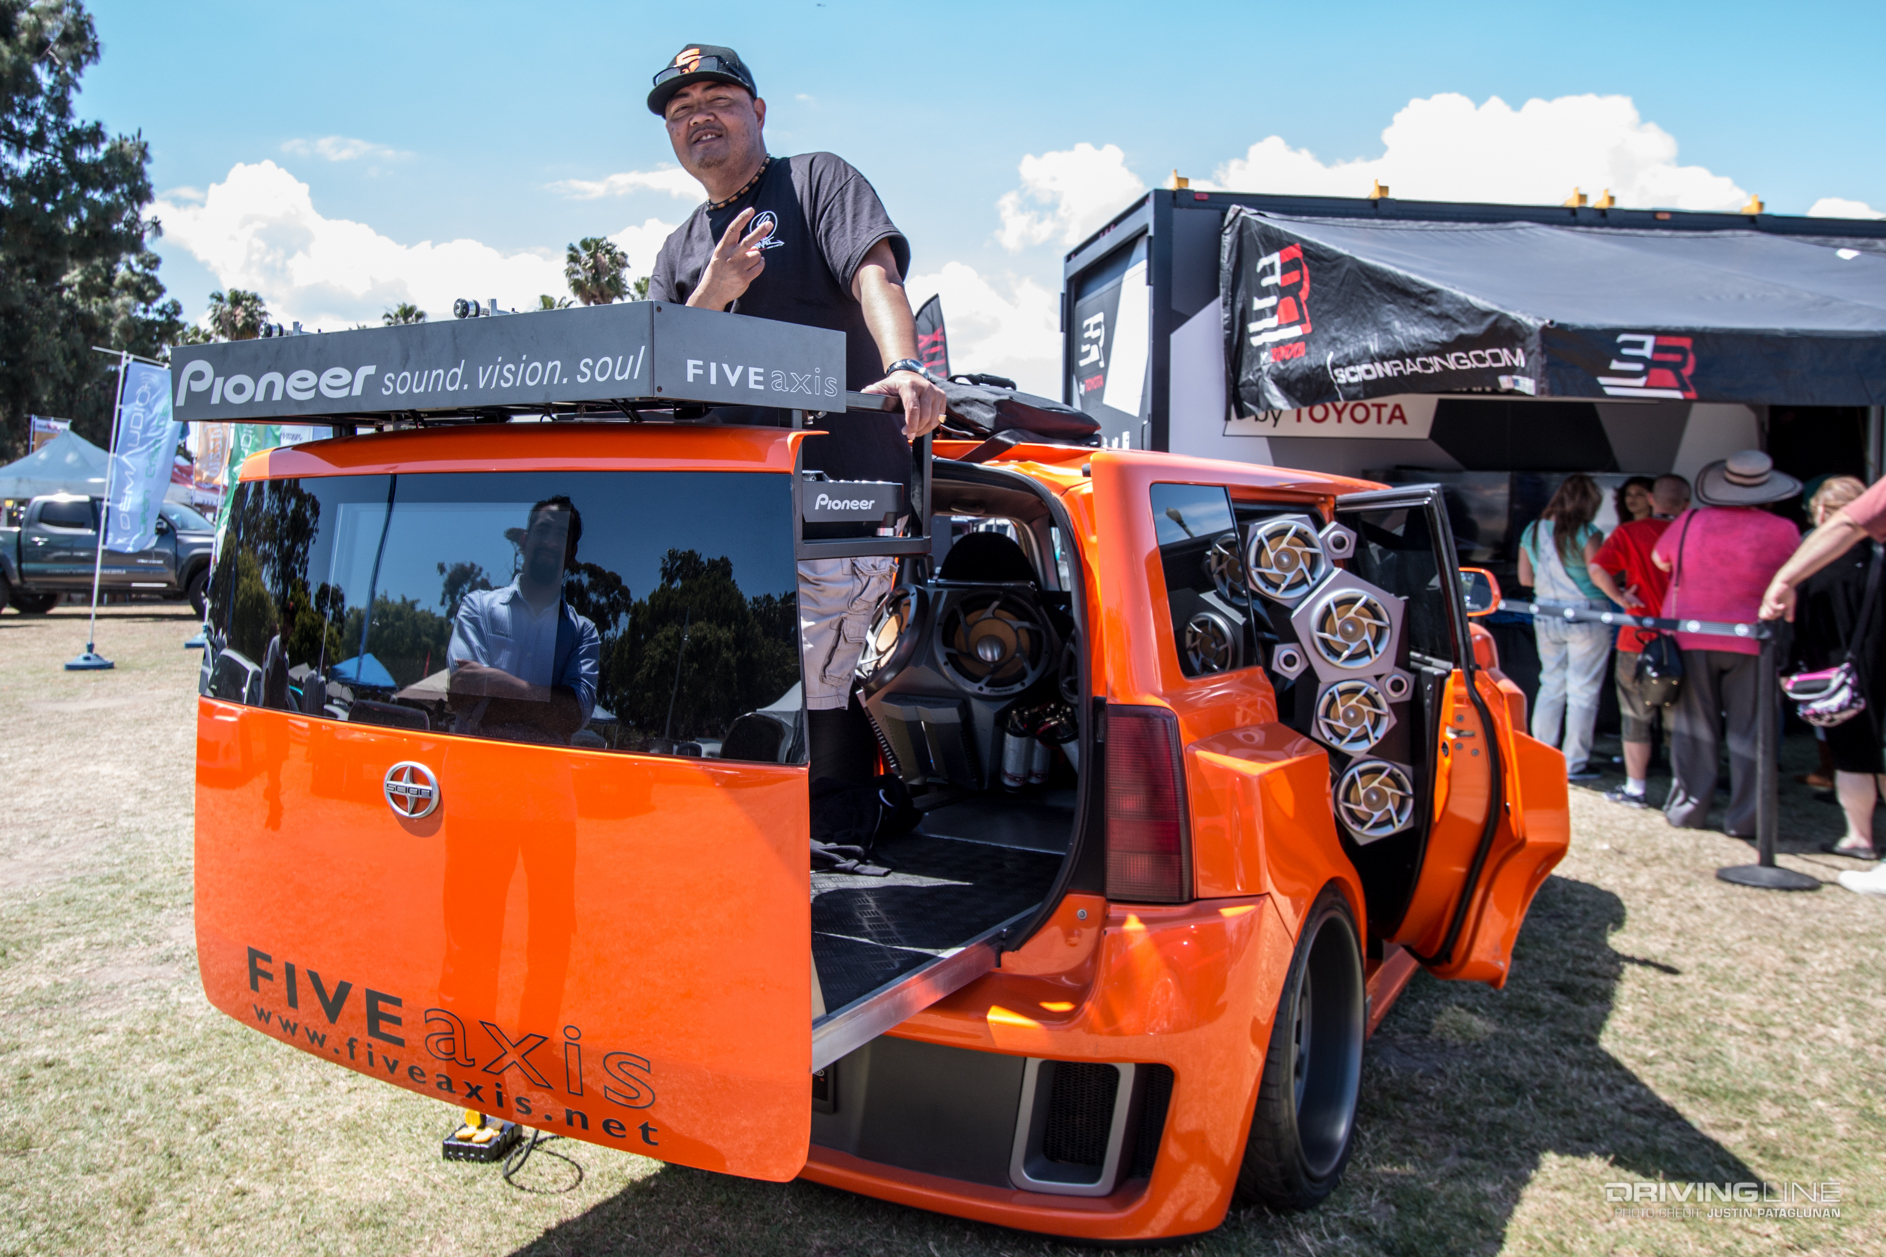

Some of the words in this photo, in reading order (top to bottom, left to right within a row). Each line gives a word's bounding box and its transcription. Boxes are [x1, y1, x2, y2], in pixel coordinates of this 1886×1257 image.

[175, 359, 377, 407] Pioneer
[381, 361, 469, 396] sound.
[478, 355, 569, 392] vision.
[576, 345, 646, 383] soul
[1333, 348, 1526, 385] SCIONRACING.COM
[815, 493, 875, 511] Pioneer
[247, 945, 406, 1048] FIVE
[424, 1008, 656, 1110] axis
[253, 1003, 659, 1147] www.fiveaxis.net
